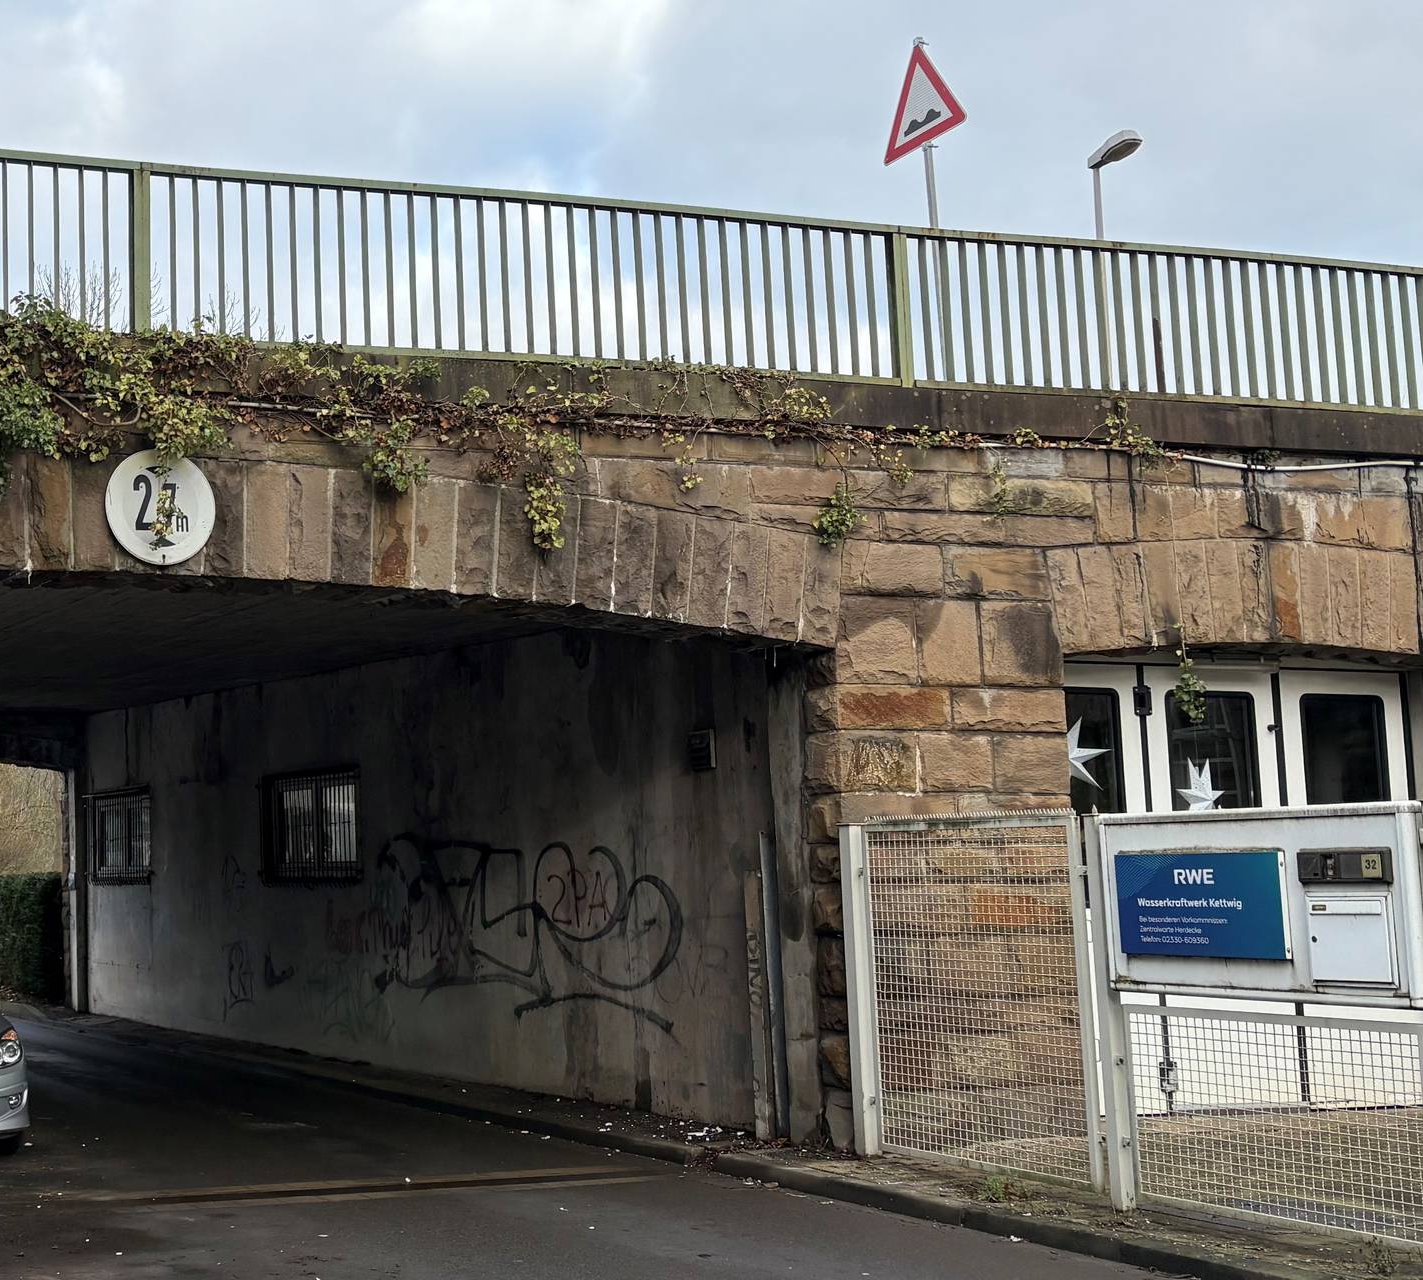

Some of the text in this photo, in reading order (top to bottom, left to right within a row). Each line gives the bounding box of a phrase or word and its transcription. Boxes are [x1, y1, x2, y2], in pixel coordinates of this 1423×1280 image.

[1365, 859, 1377, 870] 32
[1173, 868, 1215, 885] RWE
[1137, 898, 1243, 910] Wasserkraftwerk Kettwig
[1139, 915, 1148, 923] Bei
[1140, 925, 1202, 934] Zentralwarte Herdecke
